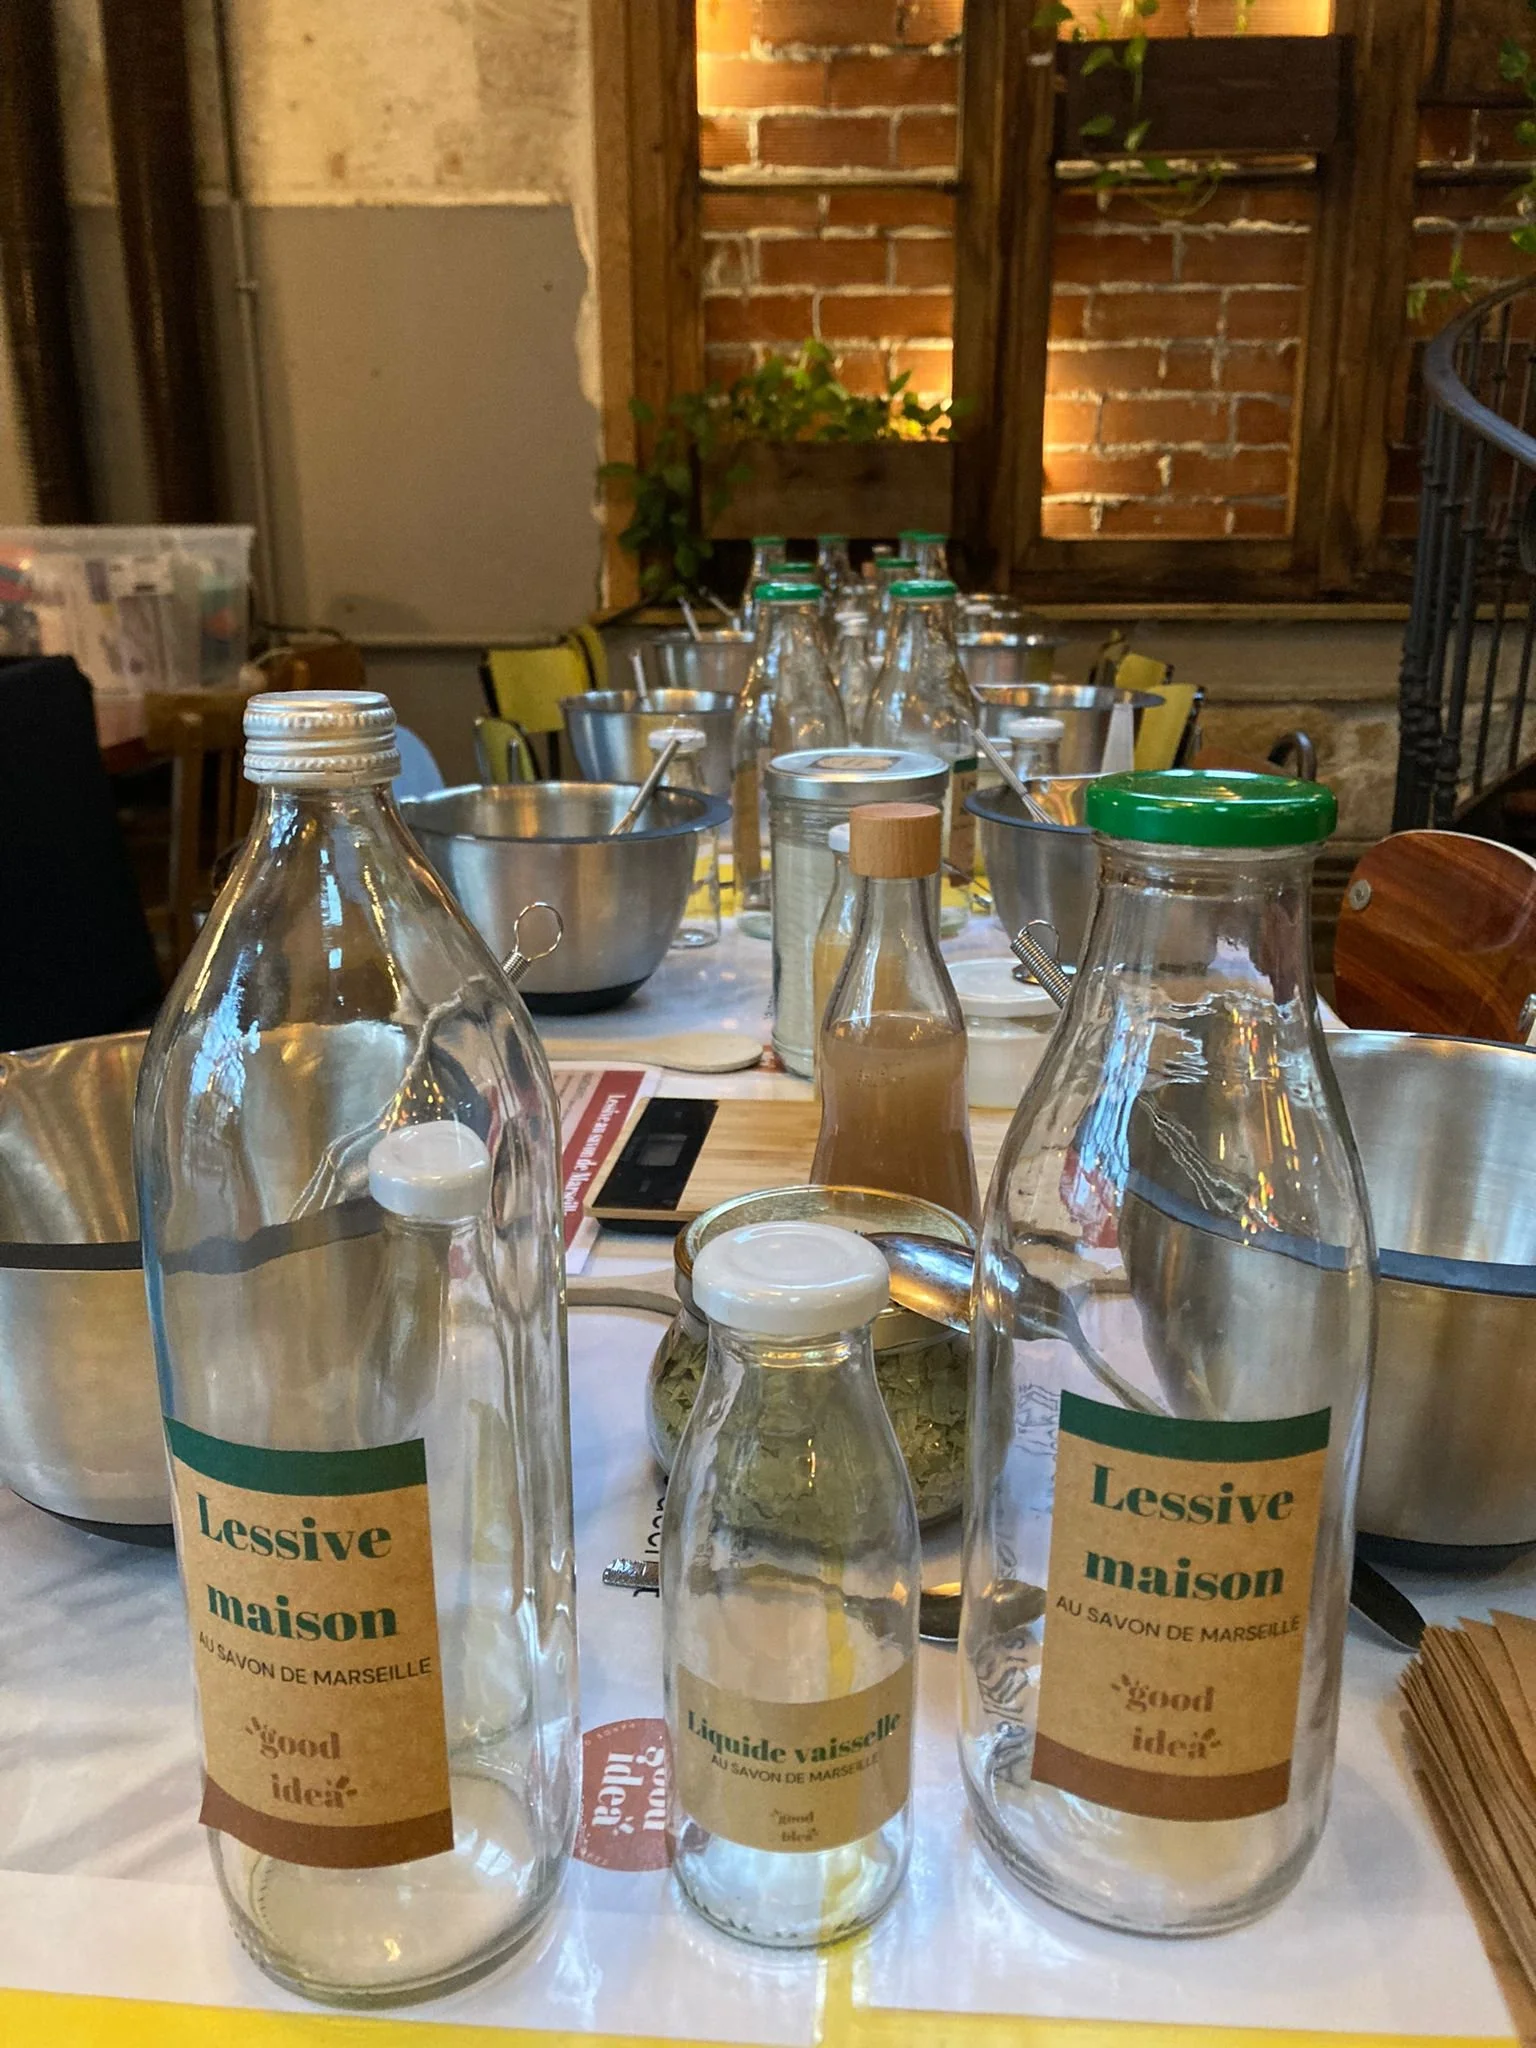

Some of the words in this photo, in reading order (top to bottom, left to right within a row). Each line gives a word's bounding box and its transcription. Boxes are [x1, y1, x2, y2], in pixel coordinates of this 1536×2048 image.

[591, 1122, 609, 1134] au
[597, 1094, 626, 1123] Lessive
[573, 1159, 597, 1171] de
[580, 1133, 603, 1158] savon
[563, 1171, 592, 1216] Marseill
[1089, 1463, 1295, 1525] Lessive
[195, 1491, 393, 1562] Lessive
[1083, 1550, 1285, 1601] maison
[206, 1583, 400, 1642] maison
[1055, 1595, 1082, 1617] AU
[1086, 1606, 1161, 1638] SAVON
[1166, 1624, 1194, 1643] DE
[1200, 1614, 1300, 1644] MARSEILLE
[199, 1631, 215, 1654] AU
[216, 1644, 275, 1680] SAVON
[280, 1666, 306, 1685] DE
[313, 1656, 433, 1686] MARSEILLE
[1124, 1679, 1215, 1714] good
[259, 1729, 341, 1760] good
[688, 1709, 787, 1764] Liquide
[793, 1712, 901, 1765] vaisselle
[1131, 1725, 1207, 1760] idea
[711, 1744, 729, 1770] AU
[730, 1761, 782, 1784] SAVON
[785, 1771, 806, 1784] DE
[808, 1750, 880, 1783] MARSEILLE
[270, 1772, 345, 1809] idea
[591, 1752, 646, 1828] idea
